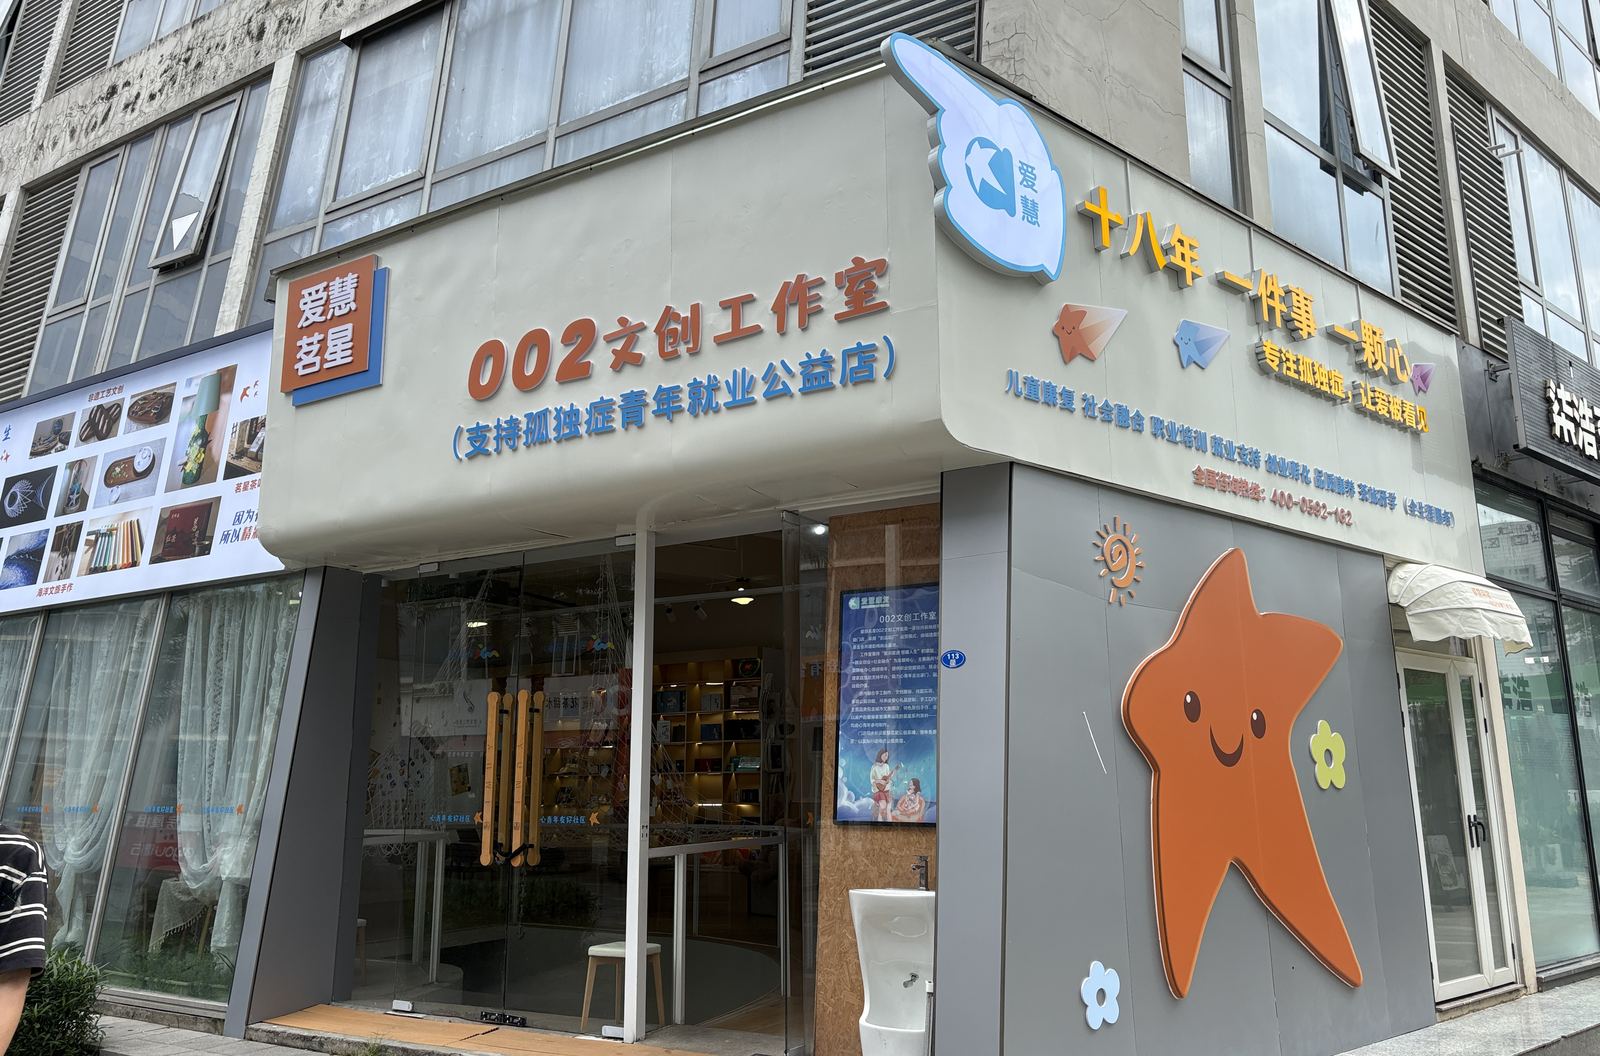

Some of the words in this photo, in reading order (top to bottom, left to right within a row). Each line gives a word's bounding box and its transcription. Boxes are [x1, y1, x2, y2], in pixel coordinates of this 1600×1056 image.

[1018, 159, 1040, 227] 爱慧
[297, 272, 359, 329] 爱慧
[1079, 185, 1203, 287] 十八年
[1215, 268, 1317, 340] 一件事
[1327, 319, 1411, 384] 一颗心
[294, 322, 354, 376] 茗星
[467, 255, 890, 401] 002文创工作室
[452, 335, 897, 461] （支持孤独症青年就业公益店）
[1005, 368, 1076, 413] 儿童康复
[1081, 392, 1145, 433] 社会融合
[1150, 416, 1208, 453] 职业培训
[1210, 434, 1262, 469] 就业支持
[1545, 379, 1600, 460] 柒浩
[232, 508, 258, 526] 因为
[879, 611, 937, 623] 002文创工作室
